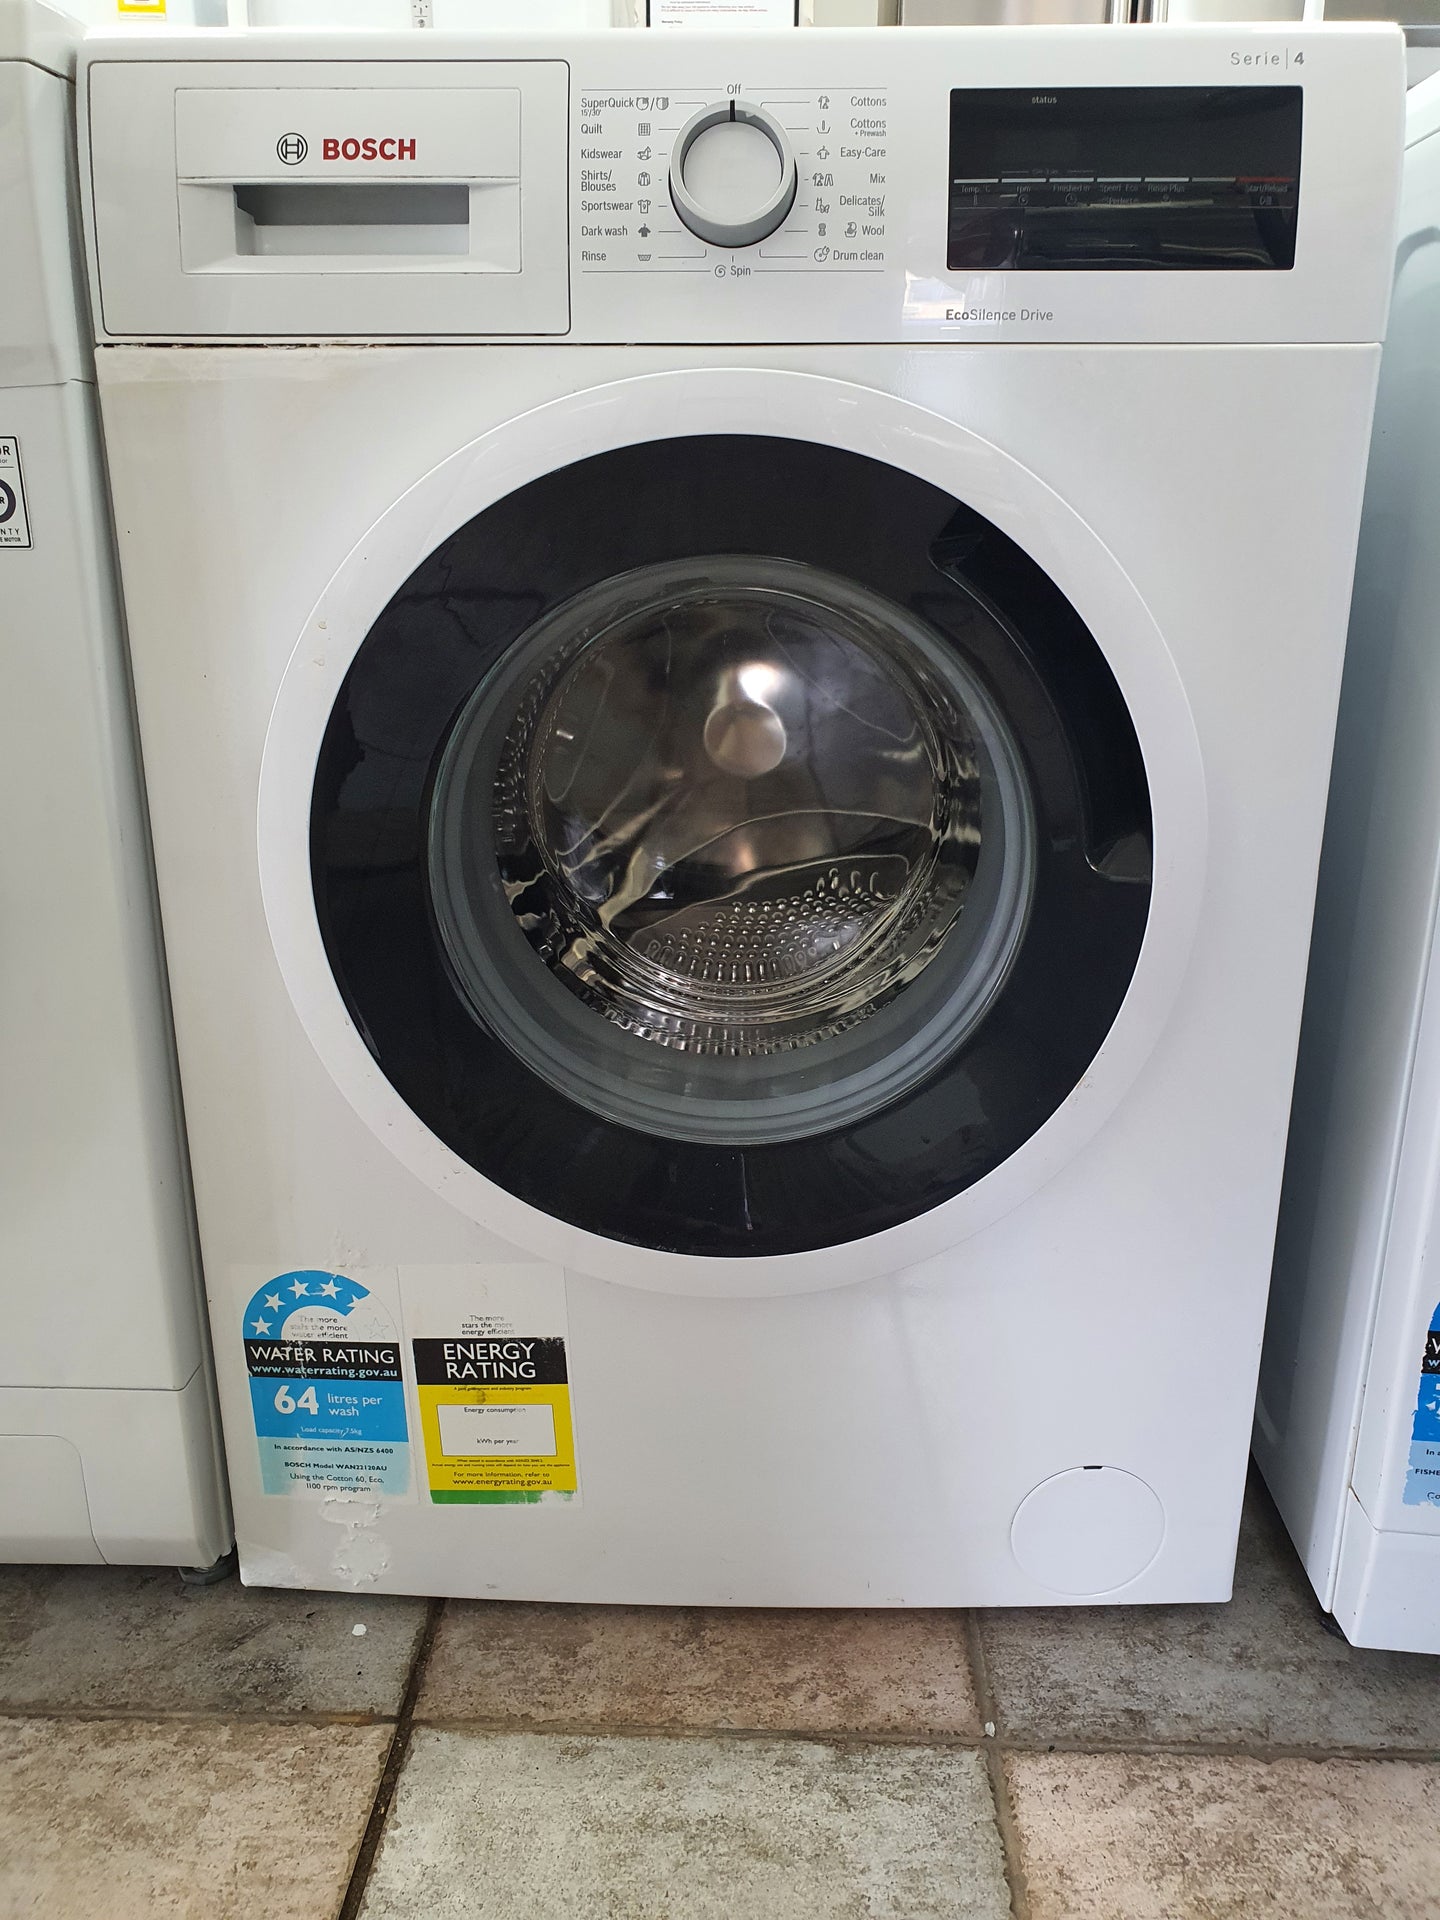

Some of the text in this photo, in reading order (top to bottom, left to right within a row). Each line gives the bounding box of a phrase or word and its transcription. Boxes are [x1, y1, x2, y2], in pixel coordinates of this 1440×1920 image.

[1230, 51, 1305, 65] Serie 4
[726, 83, 741, 95] Off
[580, 97, 634, 109] SuperQuick
[850, 96, 887, 107] Cottons
[1031, 96, 1058, 105] status
[580, 123, 603, 134] Quilt
[850, 118, 887, 129] Cottons
[859, 129, 887, 137] Prewash
[322, 137, 416, 161] BOSCH
[580, 148, 623, 159] Kidswear
[840, 146, 887, 159] Easy-Care
[580, 169, 612, 182] Shirts/
[869, 173, 886, 184] Mix
[580, 181, 617, 192] Blouses
[580, 200, 634, 212] Sportswear
[839, 195, 885, 208] Delicates/
[868, 206, 885, 217] Silk
[581, 225, 628, 236] Dark wash
[861, 225, 885, 236] Wool
[581, 250, 607, 261] Rinse
[833, 250, 884, 261] Drum clean
[730, 265, 751, 278] Spin
[945, 308, 1054, 321] EcoSilence Drive
[480, 1321, 493, 1329] the
[461, 1329, 485, 1337] energy
[250, 1346, 395, 1364] WATER RATING
[443, 1342, 536, 1361] ENERGY
[251, 1364, 398, 1378] www.waterrating.gov.au
[446, 1361, 537, 1379] RATING
[274, 1385, 319, 1416] 64
[327, 1393, 383, 1407] litres per
[328, 1405, 360, 1417] wash
[463, 1406, 485, 1414] Energy
[283, 1444, 325, 1452] accordance
[326, 1445, 343, 1453] with
[344, 1446, 375, 1454] AS/NZS
[375, 1447, 394, 1455] 6400
[289, 1472, 311, 1481] Using
[312, 1473, 325, 1481] the
[326, 1474, 354, 1482] Cotton
[323, 1484, 339, 1492] rpm
[340, 1484, 371, 1493] program
